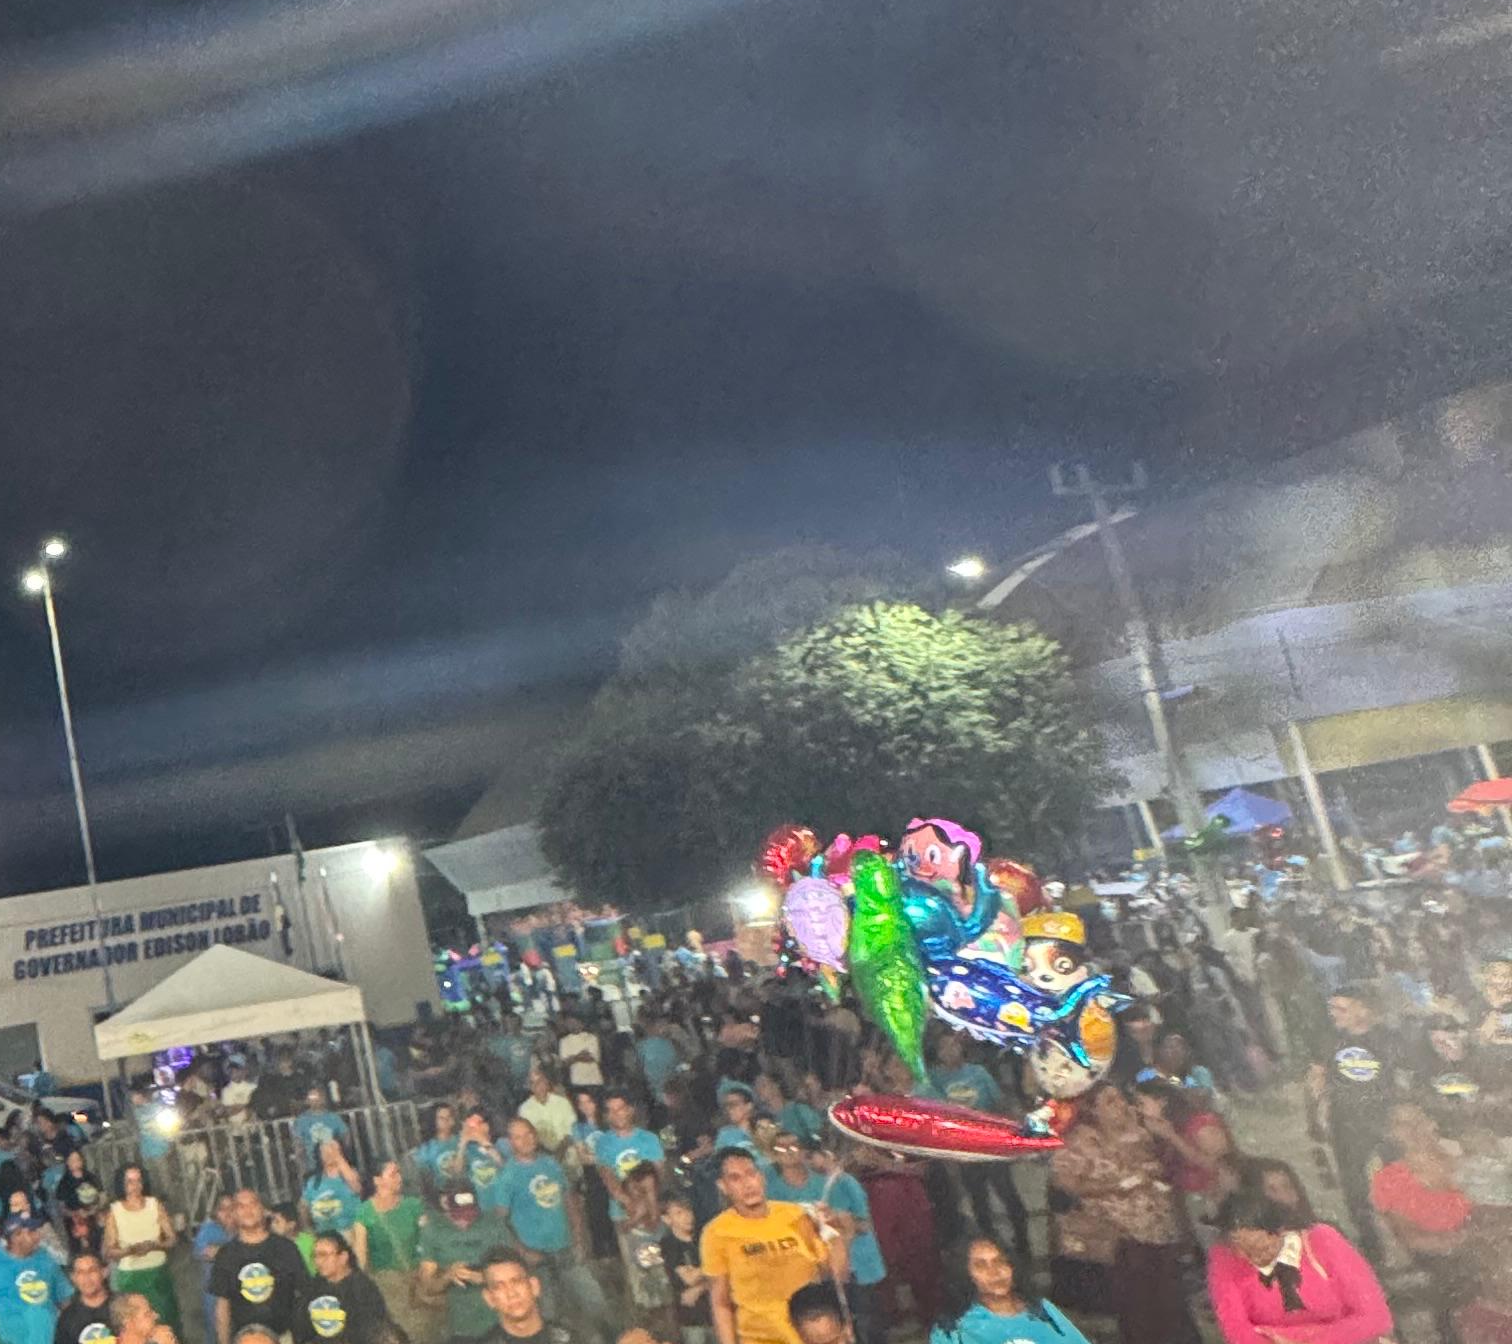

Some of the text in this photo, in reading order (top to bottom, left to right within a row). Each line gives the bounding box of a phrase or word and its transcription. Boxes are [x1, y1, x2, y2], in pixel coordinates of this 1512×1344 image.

[25, 893, 261, 951] PREFEITURA MUNICIPAL DE
[143, 929, 212, 961] EDISON
